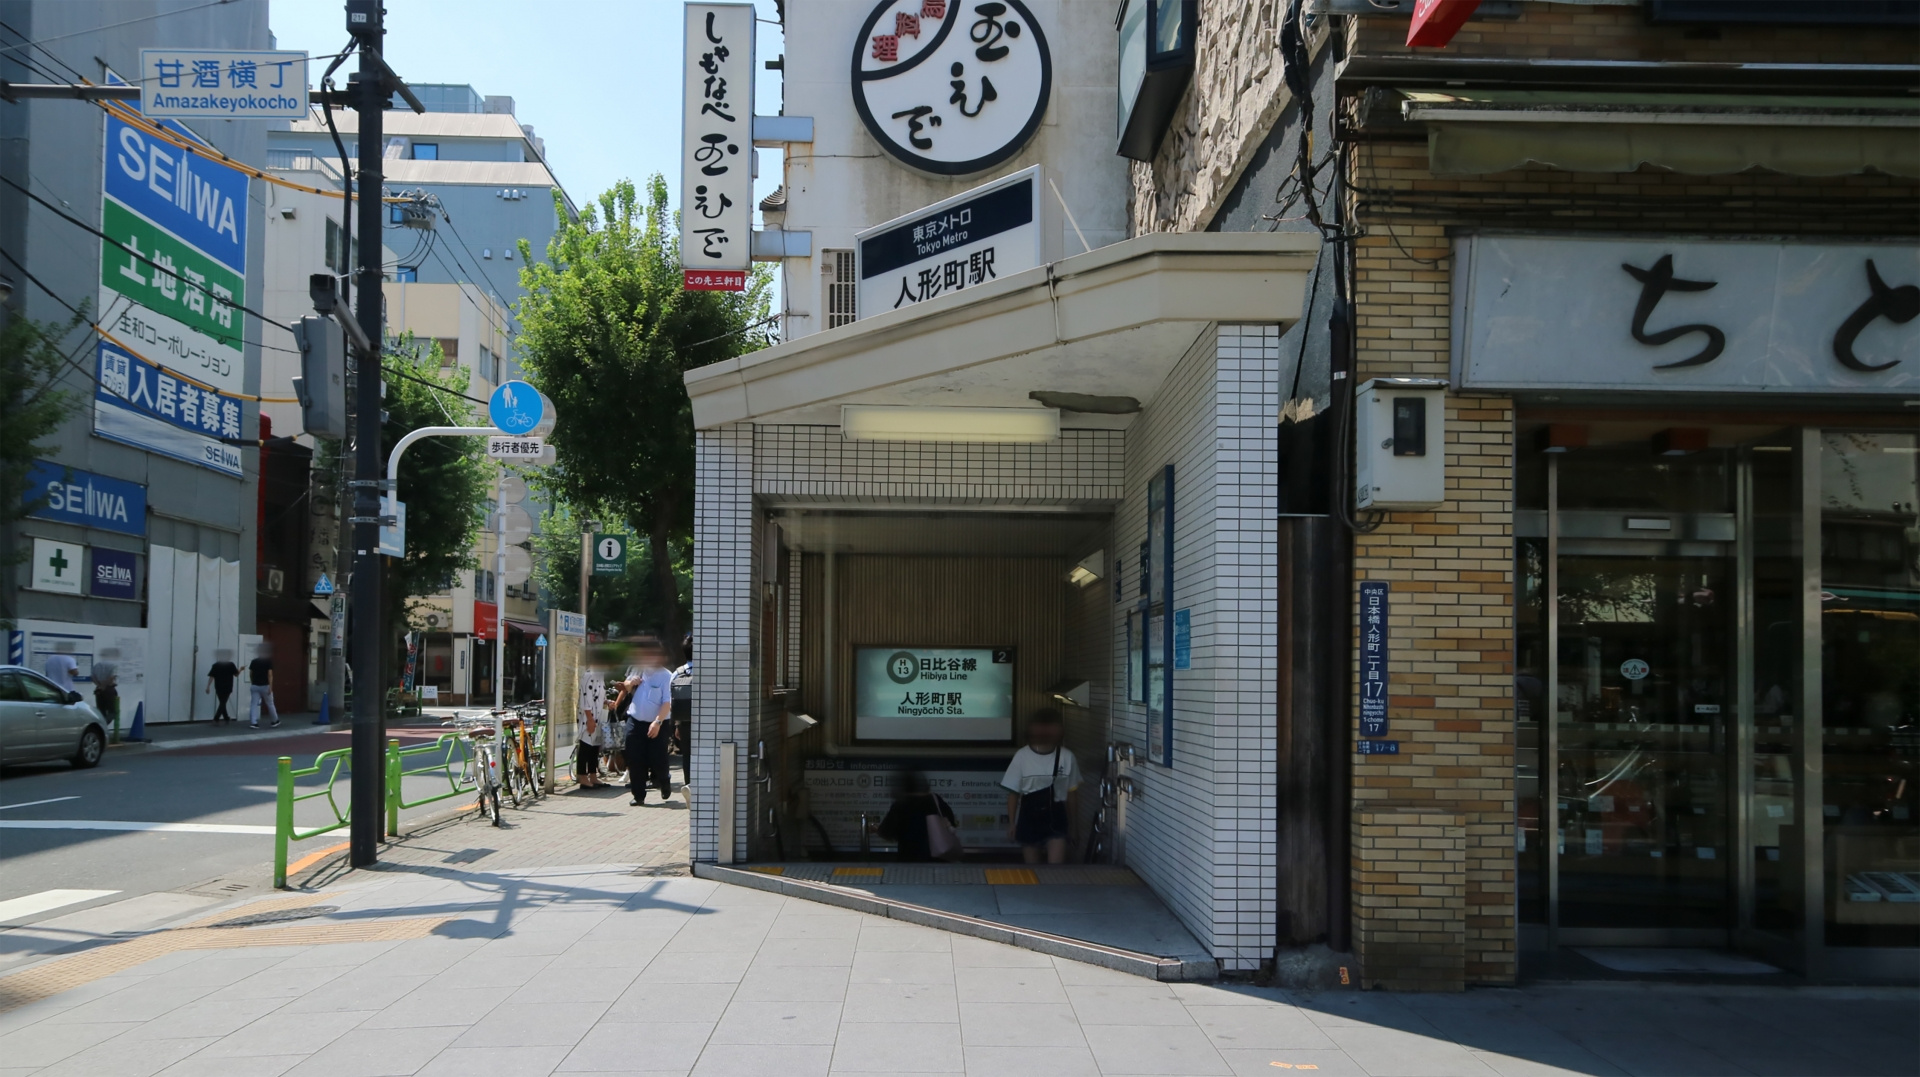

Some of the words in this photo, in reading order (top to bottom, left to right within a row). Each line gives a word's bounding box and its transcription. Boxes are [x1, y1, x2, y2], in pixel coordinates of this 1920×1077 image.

[154, 59, 294, 90] 甘酒横丁
[153, 93, 298, 113] Amazakeyokocho
[118, 126, 239, 245] SEIWA
[912, 208, 972, 243] 東京メトロ
[916, 240, 941, 256] Tokyo
[942, 230, 968, 248] Metro
[119, 235, 235, 329] 土地活用
[687, 275, 742, 287] この先三軒目
[893, 246, 997, 309] 人形町駅
[118, 312, 231, 377] 生和コーポレーション
[131, 364, 240, 439] 入居者募集
[491, 441, 540, 455] 歩行者優先
[205, 445, 240, 470] SEIWA
[47, 477, 128, 523] SEIWA
[97, 562, 132, 579] SEIWA
[1367, 596, 1381, 680] 日本橋人形町一丁目
[899, 659, 906, 667] H
[920, 658, 977, 672] 日比谷線
[998, 652, 1007, 663] 2
[897, 667, 910, 675] 13
[920, 672, 948, 681] Hibiya
[949, 672, 968, 680] Line
[1364, 681, 1384, 697] 17
[900, 691, 962, 706] 人形町駅
[897, 705, 944, 717] Ningyōchō
[946, 706, 965, 715] Sta.
[1368, 723, 1380, 732] 17
[805, 759, 845, 769] お知らせ
